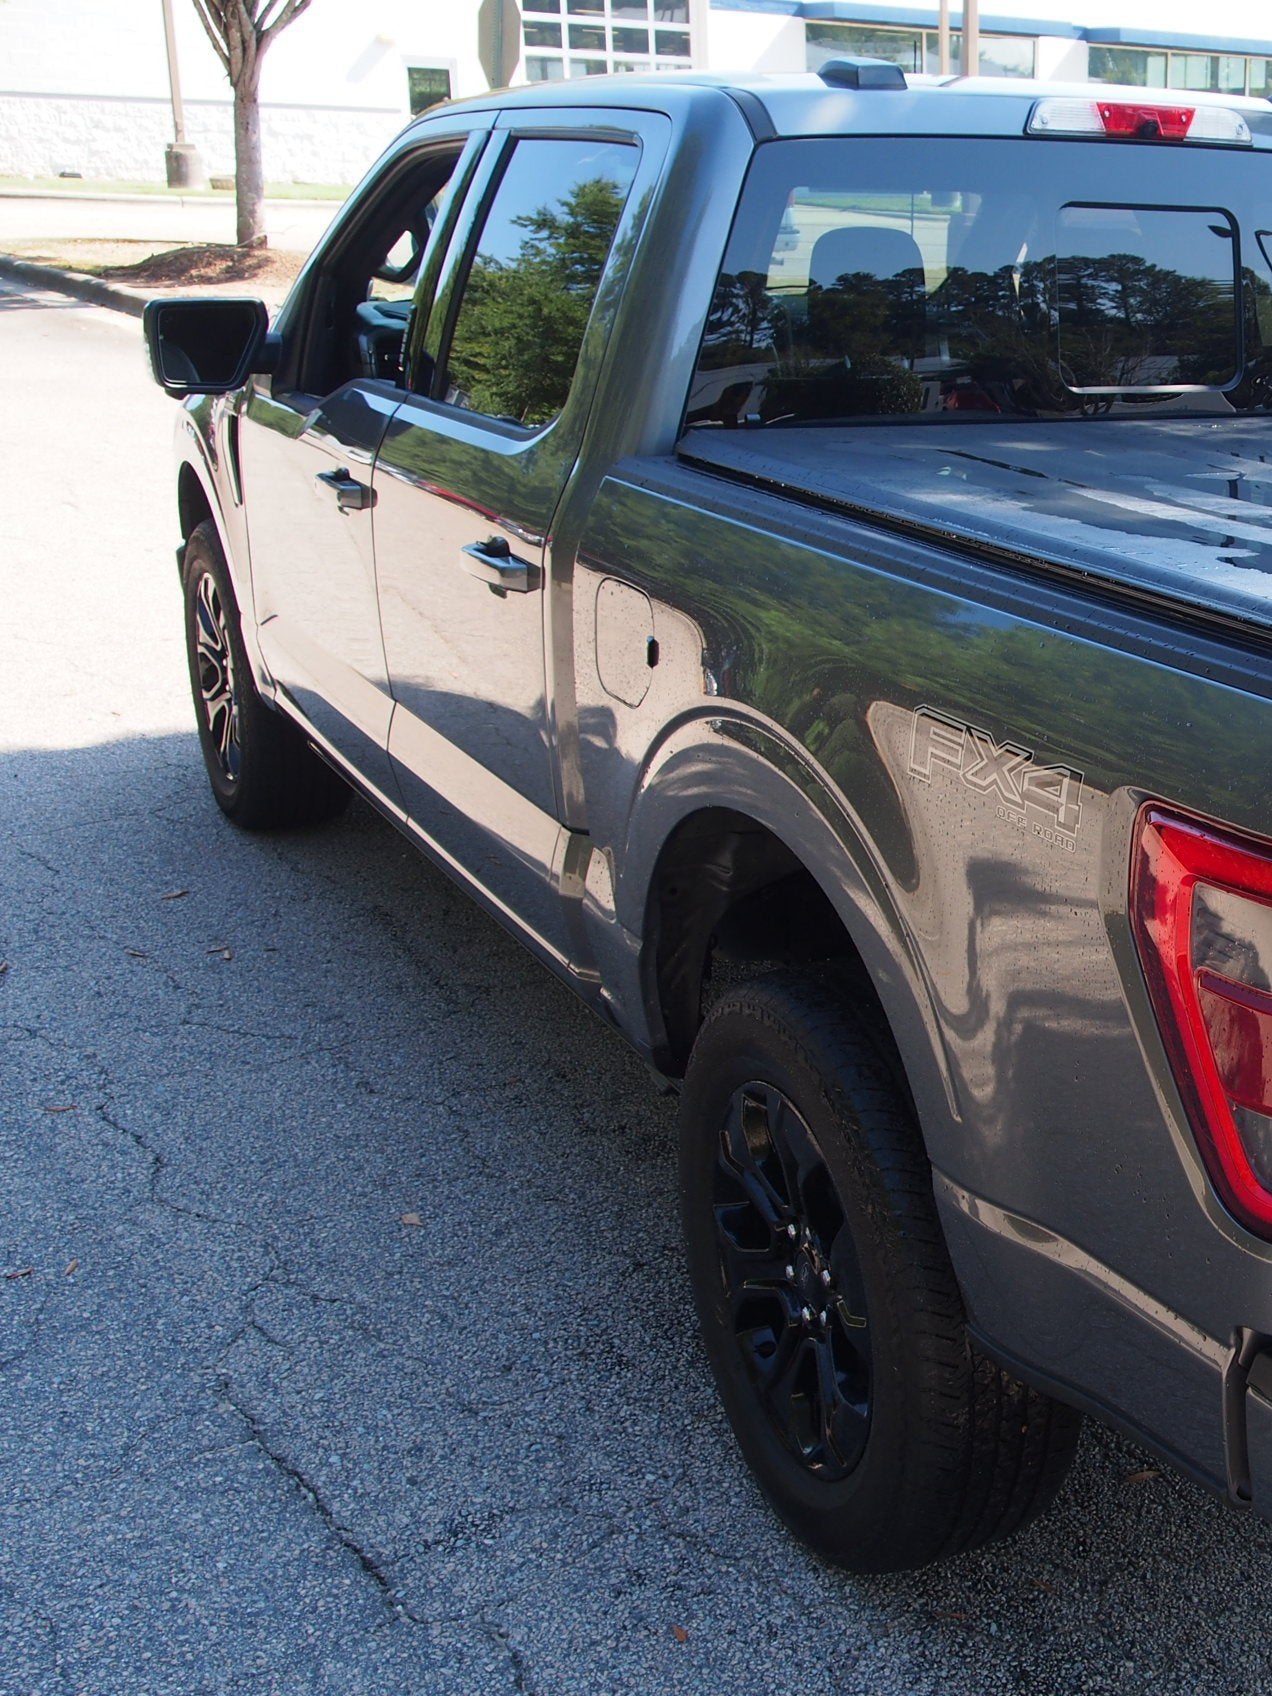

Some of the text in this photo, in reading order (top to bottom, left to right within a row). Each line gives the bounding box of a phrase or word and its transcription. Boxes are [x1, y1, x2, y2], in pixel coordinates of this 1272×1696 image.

[907, 703, 1085, 837] FX4
[996, 805, 1077, 853] OFF ROAD
